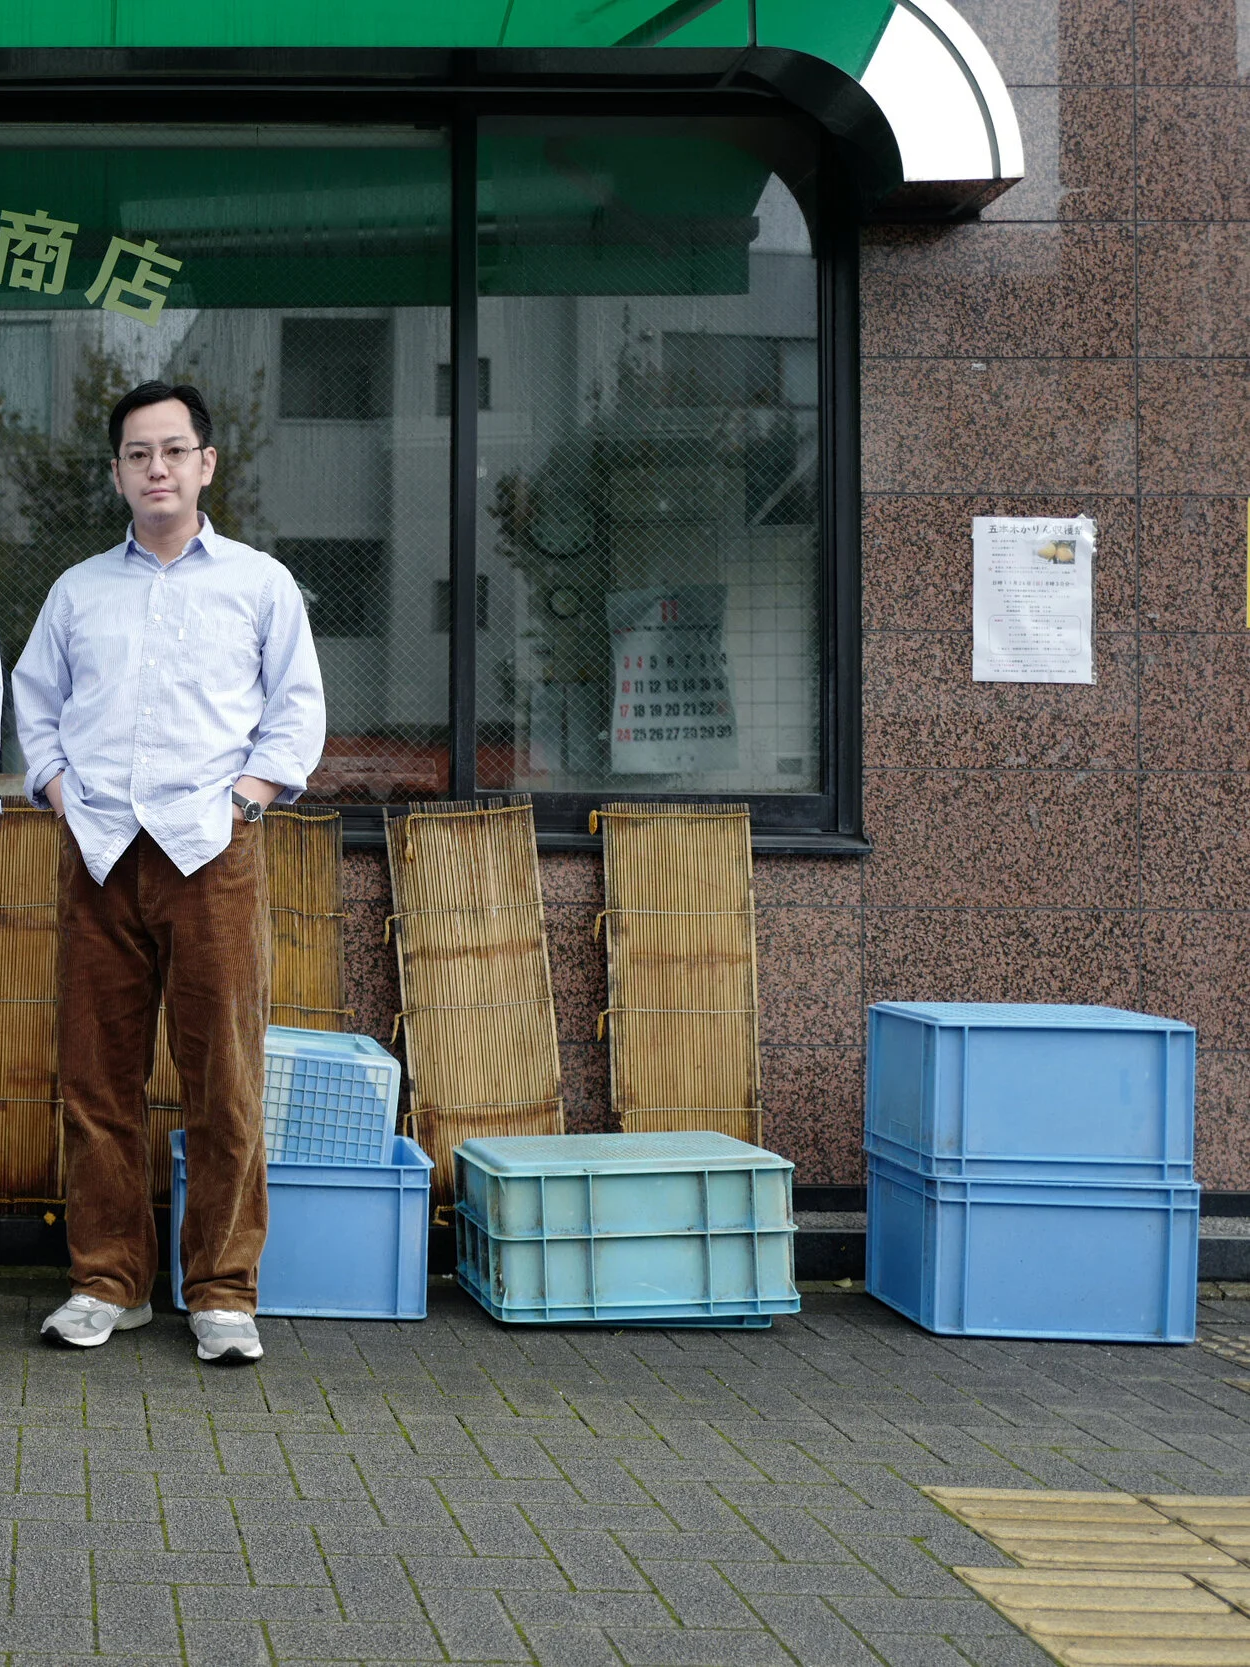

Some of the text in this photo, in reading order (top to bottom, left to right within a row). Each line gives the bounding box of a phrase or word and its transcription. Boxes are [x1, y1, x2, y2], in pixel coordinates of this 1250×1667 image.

[634, 680, 644, 693] 11
[649, 680, 661, 694] 12
[620, 704, 629, 718] 17
[633, 704, 645, 717] 18
[649, 704, 662, 717] 19
[664, 703, 680, 716] 20
[683, 702, 696, 716] 21
[616, 727, 631, 741] 24
[632, 727, 646, 741] 25
[649, 727, 663, 741] 26
[666, 727, 680, 741] 27
